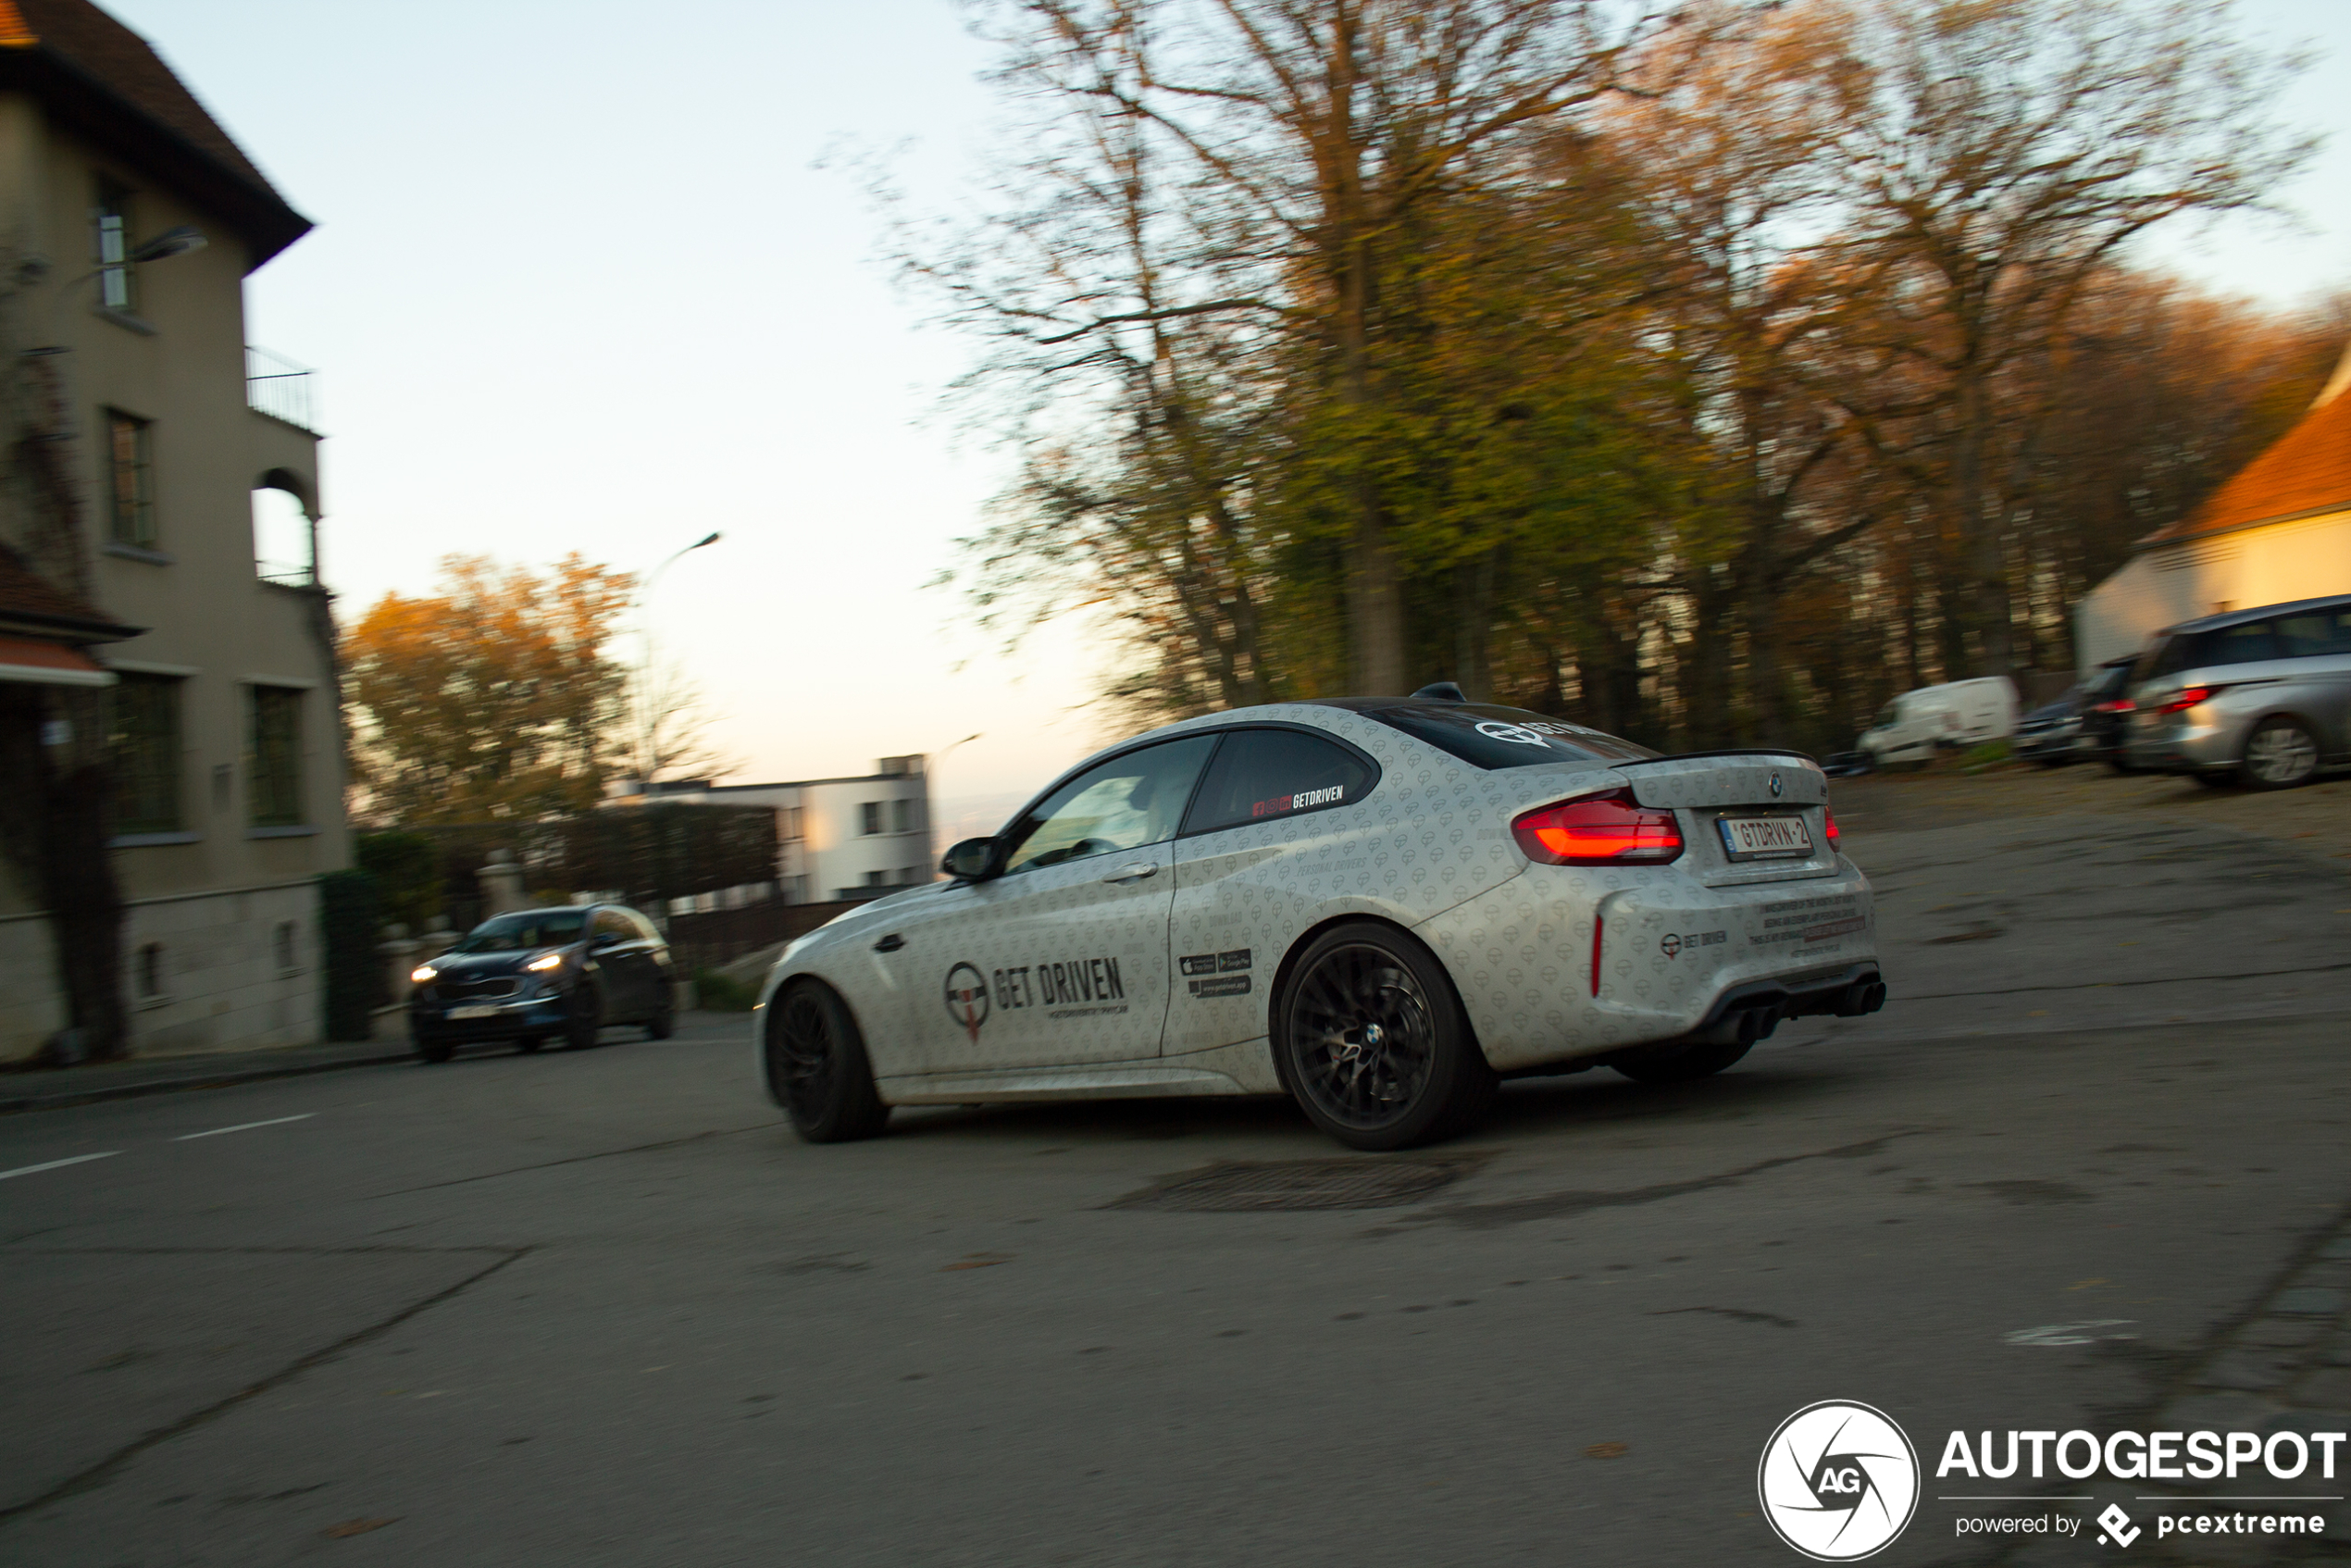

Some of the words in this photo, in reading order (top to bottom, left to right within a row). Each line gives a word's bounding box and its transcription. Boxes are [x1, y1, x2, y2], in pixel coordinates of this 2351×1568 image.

[1293, 784, 1343, 809] GETDRIVEN
[1297, 861, 1333, 877] PERSONAL
[1334, 856, 1367, 872] DRIVERS
[1683, 934, 1699, 949] GET
[993, 966, 1033, 1010] GET
[1038, 956, 1126, 1005] DRIVEN
